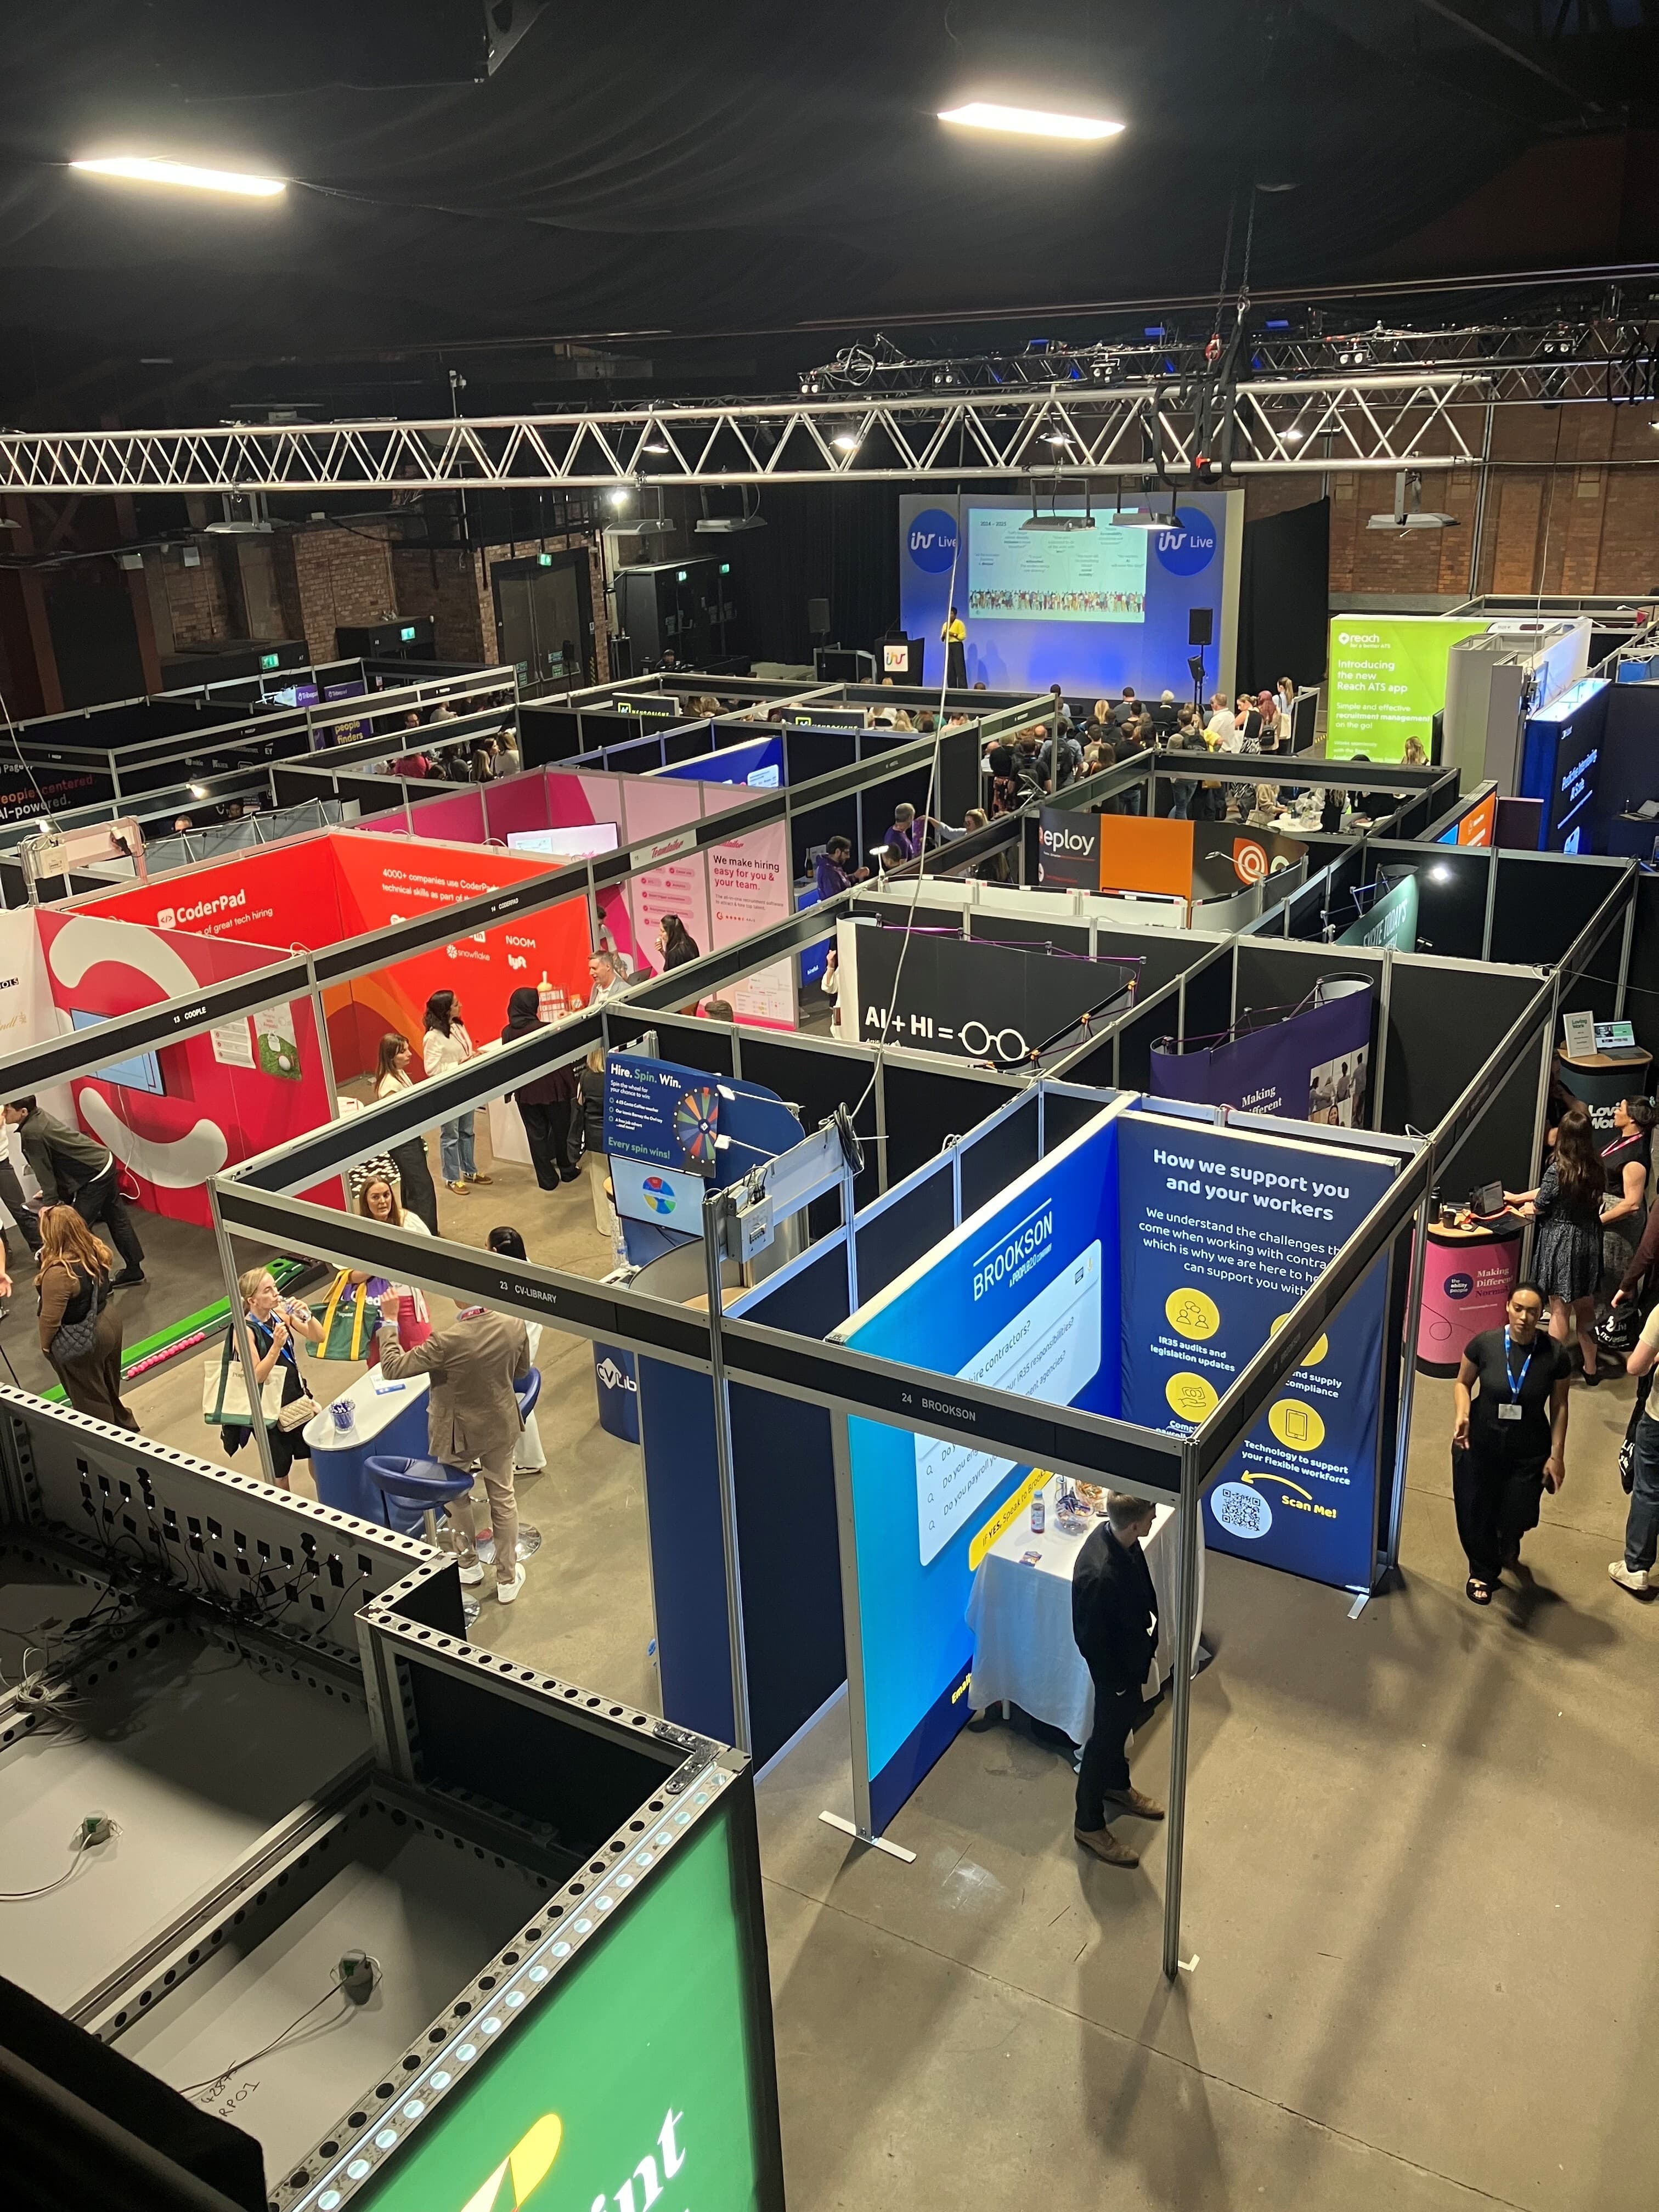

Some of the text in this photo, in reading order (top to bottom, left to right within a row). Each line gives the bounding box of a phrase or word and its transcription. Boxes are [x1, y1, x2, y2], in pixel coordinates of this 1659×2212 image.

[1159, 532, 1214, 551] ihr Live
[1350, 634, 1380, 643] reach
[886, 652, 906, 665] ihr
[1338, 659, 1395, 672] Introducing
[1338, 671, 1353, 679] the
[1337, 681, 1408, 695] Reach ATS app
[1336, 702, 1361, 710] Simple
[1378, 703, 1411, 712] effective
[335, 720, 360, 735] people
[1380, 715, 1431, 723] management
[337, 731, 364, 746] finders
[713, 855, 780, 873] We make hiring
[714, 867, 775, 881] easy for you &
[383, 868, 459, 888] 4000+ companies use
[714, 878, 760, 890] your team.
[382, 883, 411, 895] technical
[413, 888, 429, 898] skills
[439, 893, 454, 902] part
[176, 888, 246, 923] CoderPad
[498, 898, 519, 910] CODERPAD
[213, 919, 233, 934] great
[234, 912, 251, 926] tech
[251, 908, 273, 921] hiring
[505, 935, 536, 949] NOOM
[458, 949, 490, 961] snowflake
[173, 1006, 207, 1024] 13 COOPLE
[865, 1006, 886, 1029] AI
[891, 1015, 906, 1032] +
[911, 1013, 933, 1039] HI
[610, 1080, 620, 1088] Spin
[628, 1084, 641, 1093] wheel
[611, 1063, 682, 1089] Hire. Spin. Win.
[620, 1089, 636, 1097] chance
[1242, 1086, 1277, 1108] Making
[608, 1137, 671, 1160] Every spin wins!
[1153, 1148, 1350, 1200] How we support you
[1166, 1176, 1334, 1221] and your workers
[1146, 1206, 1325, 1253] We understand the challenges
[1138, 1222, 1170, 1236] come
[1172, 1229, 1204, 1244] when
[1206, 1237, 1255, 1256] working
[1257, 1247, 1284, 1261] with
[973, 1210, 1052, 1302] BROOKSON
[1143, 1237, 1302, 1280] which is why we are here to
[1183, 1262, 1307, 1296] can support you with
[1476, 1276, 1514, 1288] Different
[1477, 1268, 1510, 1278] Making
[500, 1280, 557, 1304] 23 CV-LIBRARY
[985, 1319, 1031, 1373] contractors?
[1017, 1316, 1075, 1383] IR35 responsibilities?
[1159, 1335, 1227, 1359] IR35 audits and
[1040, 1350, 1066, 1385] agencies?
[1150, 1344, 1235, 1372] legislation updates
[1309, 1373, 1342, 1389] supply
[901, 1392, 977, 1422] 24 BROOKSON
[941, 1448, 952, 1462] Do
[1244, 1439, 1349, 1475] Technology to support
[943, 1460, 966, 1489] Do you
[1242, 1450, 1351, 1486] your flexible workforce
[944, 1457, 990, 1516] Do you payroll
[989, 1491, 1028, 1539] YES, Speak to
[1282, 1494, 1338, 1519] Scan Me!
